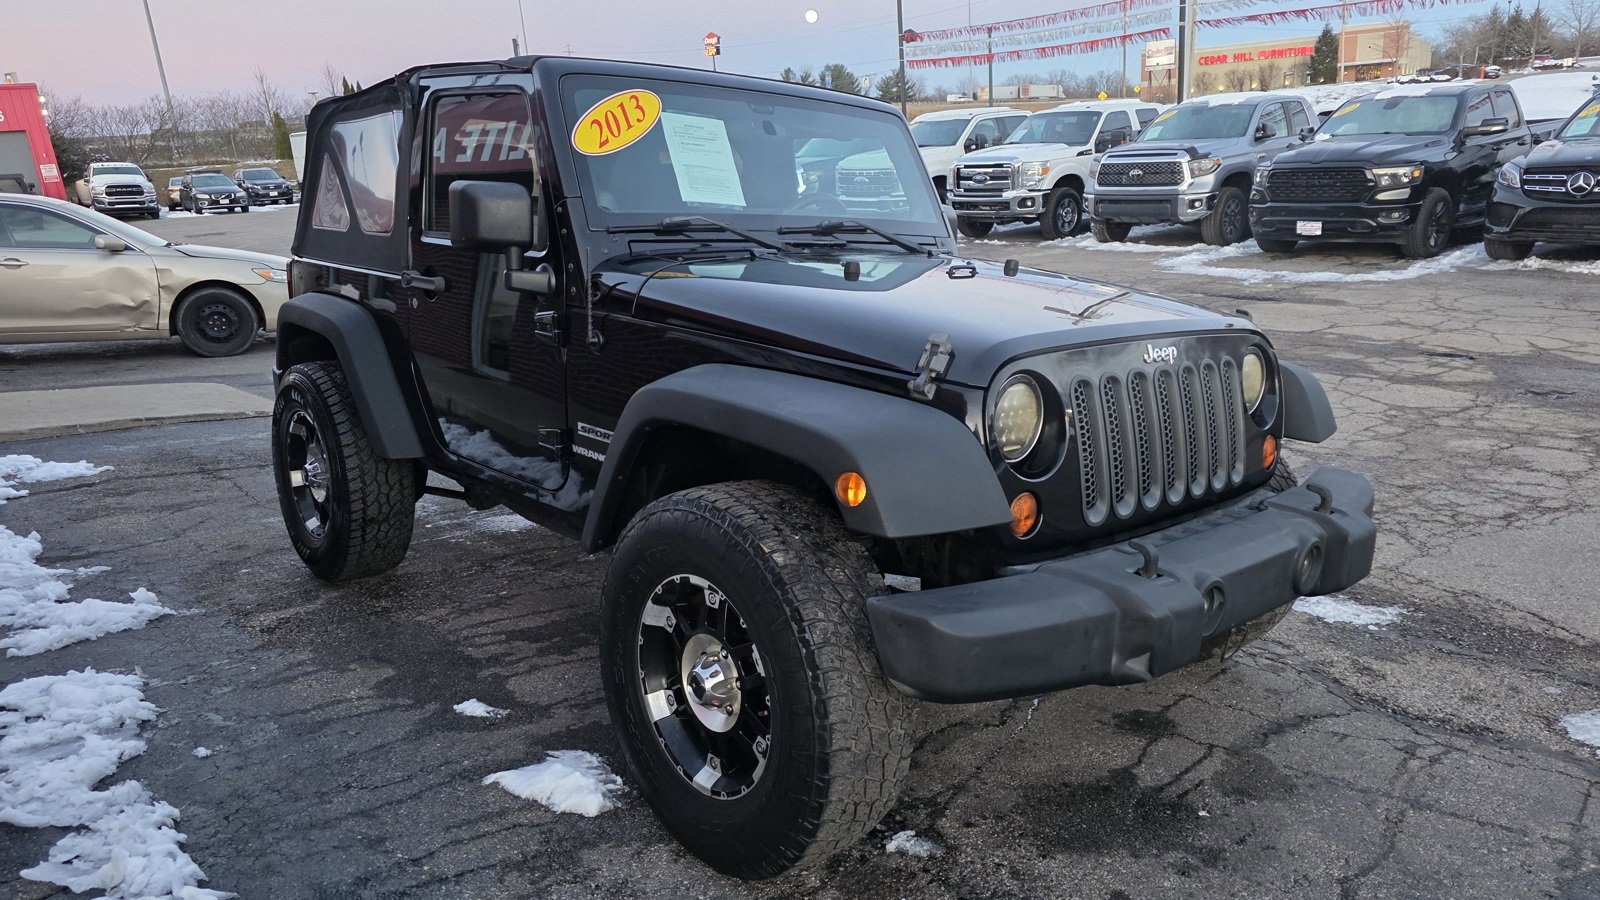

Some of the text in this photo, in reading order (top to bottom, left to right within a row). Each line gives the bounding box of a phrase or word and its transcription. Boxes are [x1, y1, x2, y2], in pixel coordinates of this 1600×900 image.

[1198, 46, 1313, 65] CEDAR HILL FURNITURE
[590, 94, 646, 149] 2013
[1143, 344, 1177, 364] Jeep
[578, 422, 614, 443] SPOR
